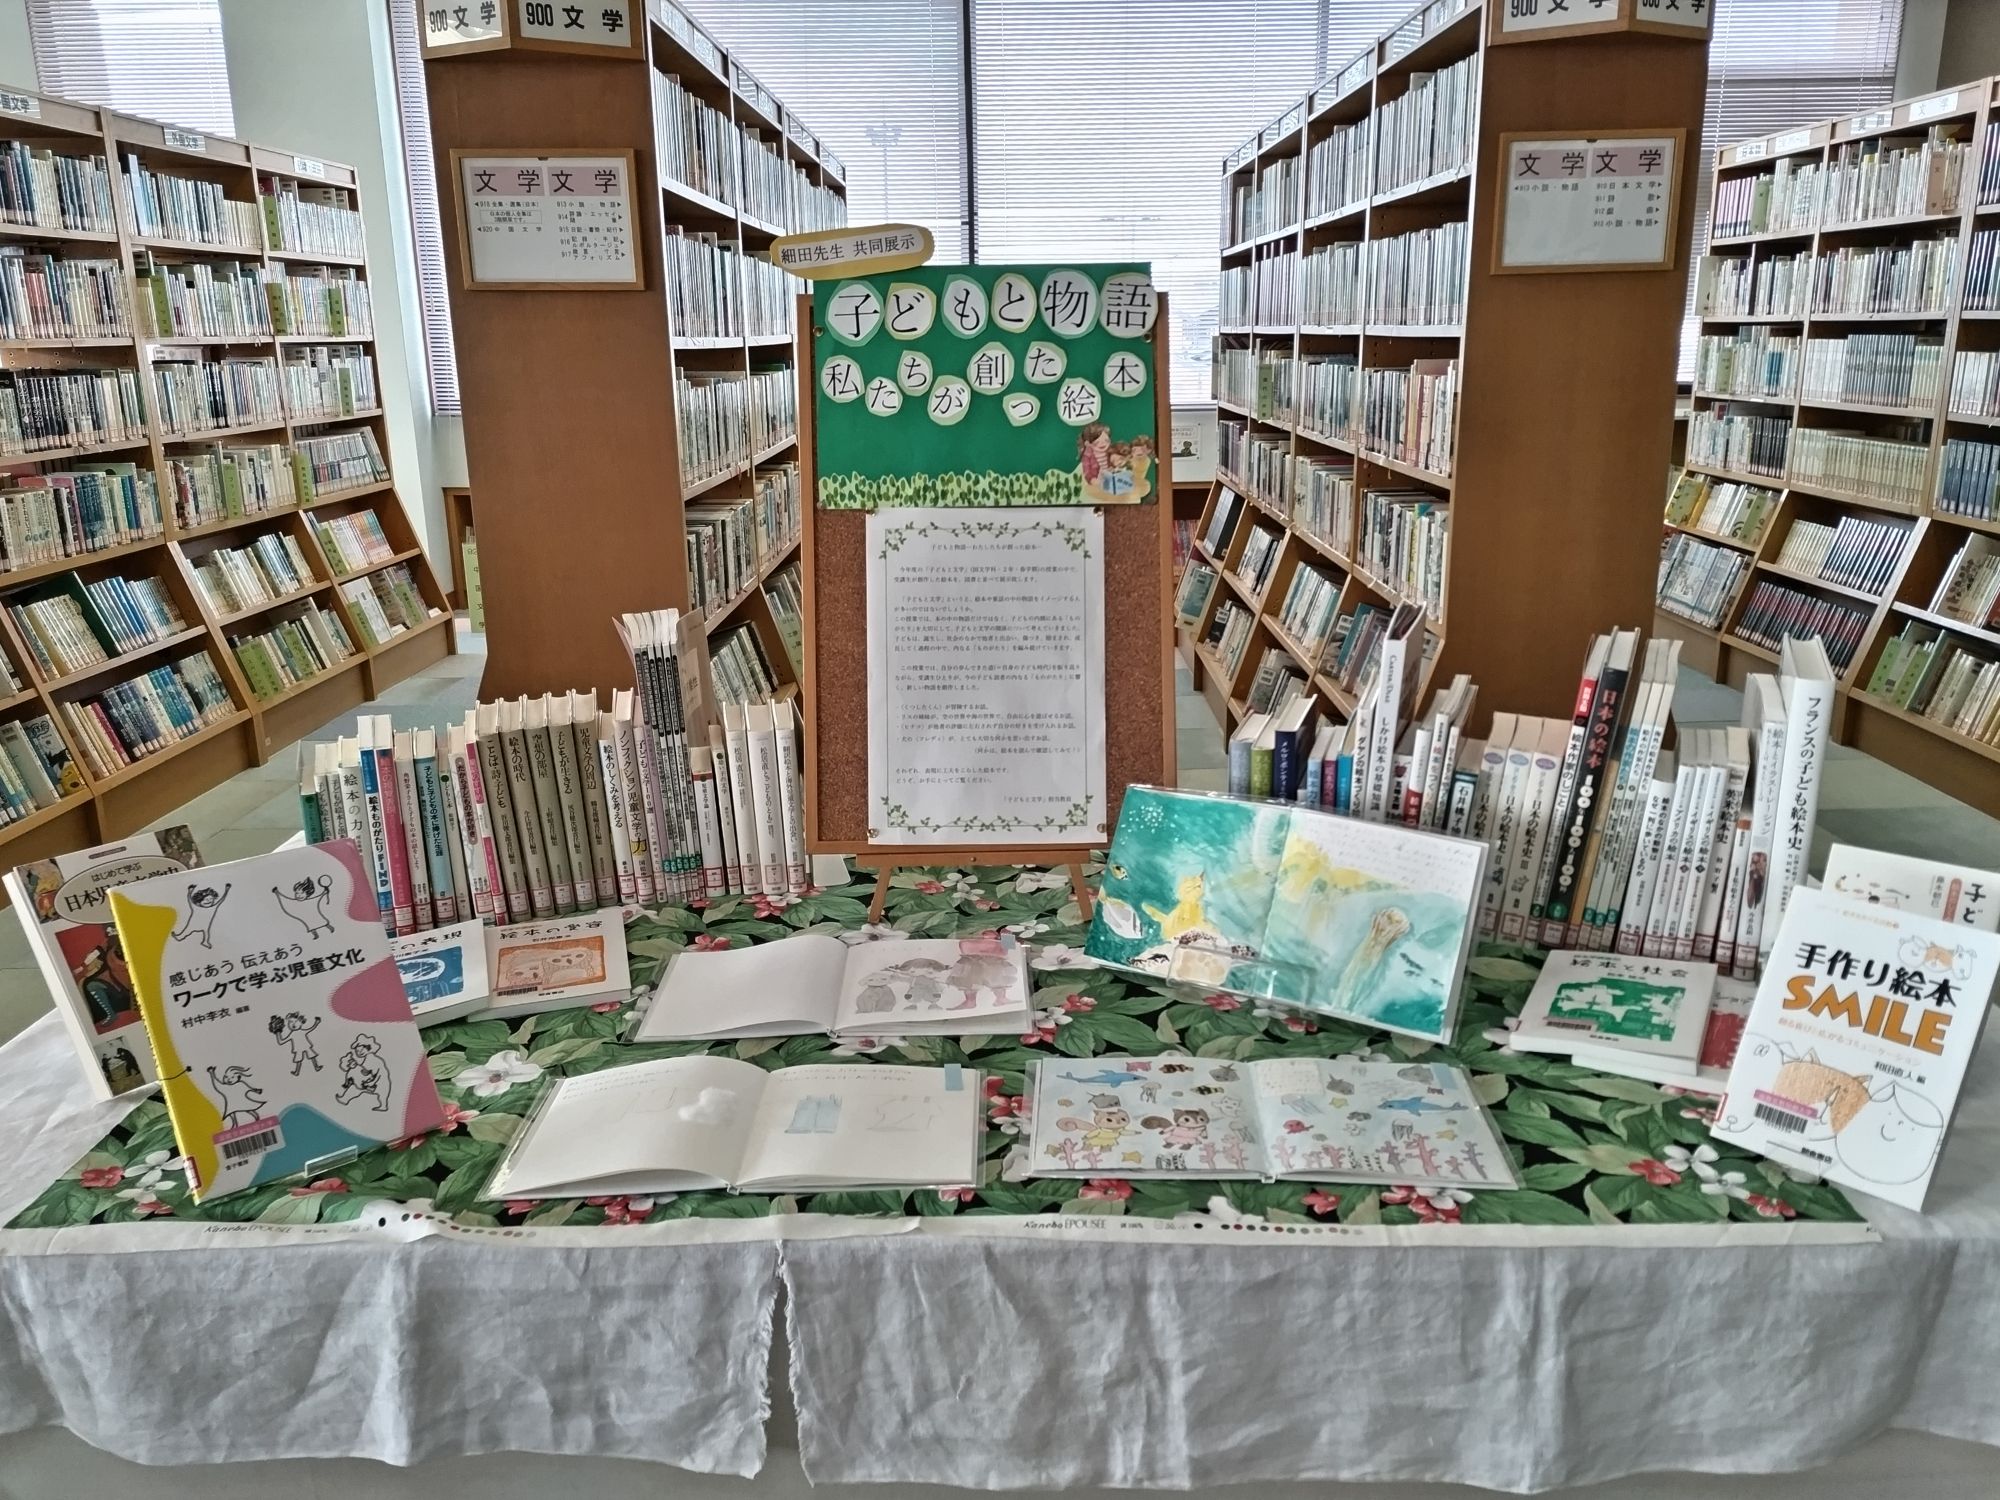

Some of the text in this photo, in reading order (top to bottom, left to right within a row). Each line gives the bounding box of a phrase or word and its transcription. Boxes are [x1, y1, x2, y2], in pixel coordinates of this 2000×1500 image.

[428, 1, 496, 33] 900 文学
[526, 2, 624, 33] 900 文学
[474, 169, 540, 193] 文学
[551, 169, 617, 193] 文学
[1519, 152, 1585, 176] 文学
[1595, 149, 1661, 174] 文学
[1609, 181, 1657, 190] 日本文学
[781, 233, 916, 264] 細田先生 共同展示
[834, 279, 1152, 338] 子どもと物語
[1586, 690, 1617, 769] 日本の絵本
[508, 736, 526, 782] 絵本の時代
[1787, 696, 1822, 852] フランスの子ども絵本史
[343, 774, 363, 831] 絵本の力
[169, 943, 304, 988] 感じあう 伝えあう
[173, 948, 366, 1008] ワークで学ぶ児童文化
[1794, 942, 1962, 1008] 手作り絵本
[1783, 975, 1953, 1057] SMILE
